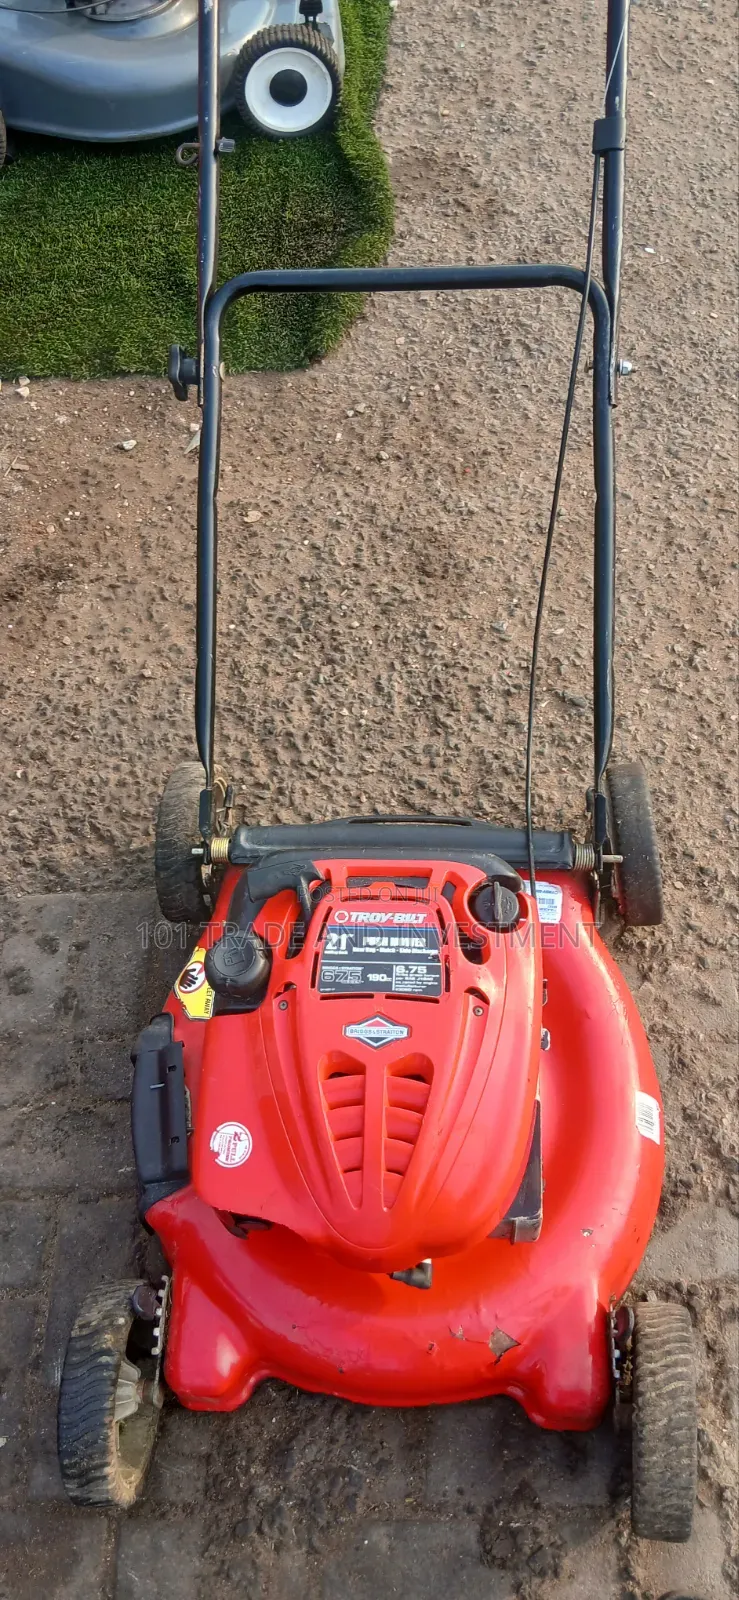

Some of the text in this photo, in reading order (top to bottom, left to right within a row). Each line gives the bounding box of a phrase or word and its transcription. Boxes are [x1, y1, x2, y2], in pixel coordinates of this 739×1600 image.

[349, 911, 427, 924] TROY-BILT
[321, 969, 362, 983] 675
[395, 965, 427, 974] 6.75
[203, 998, 212, 1014] AWAY
